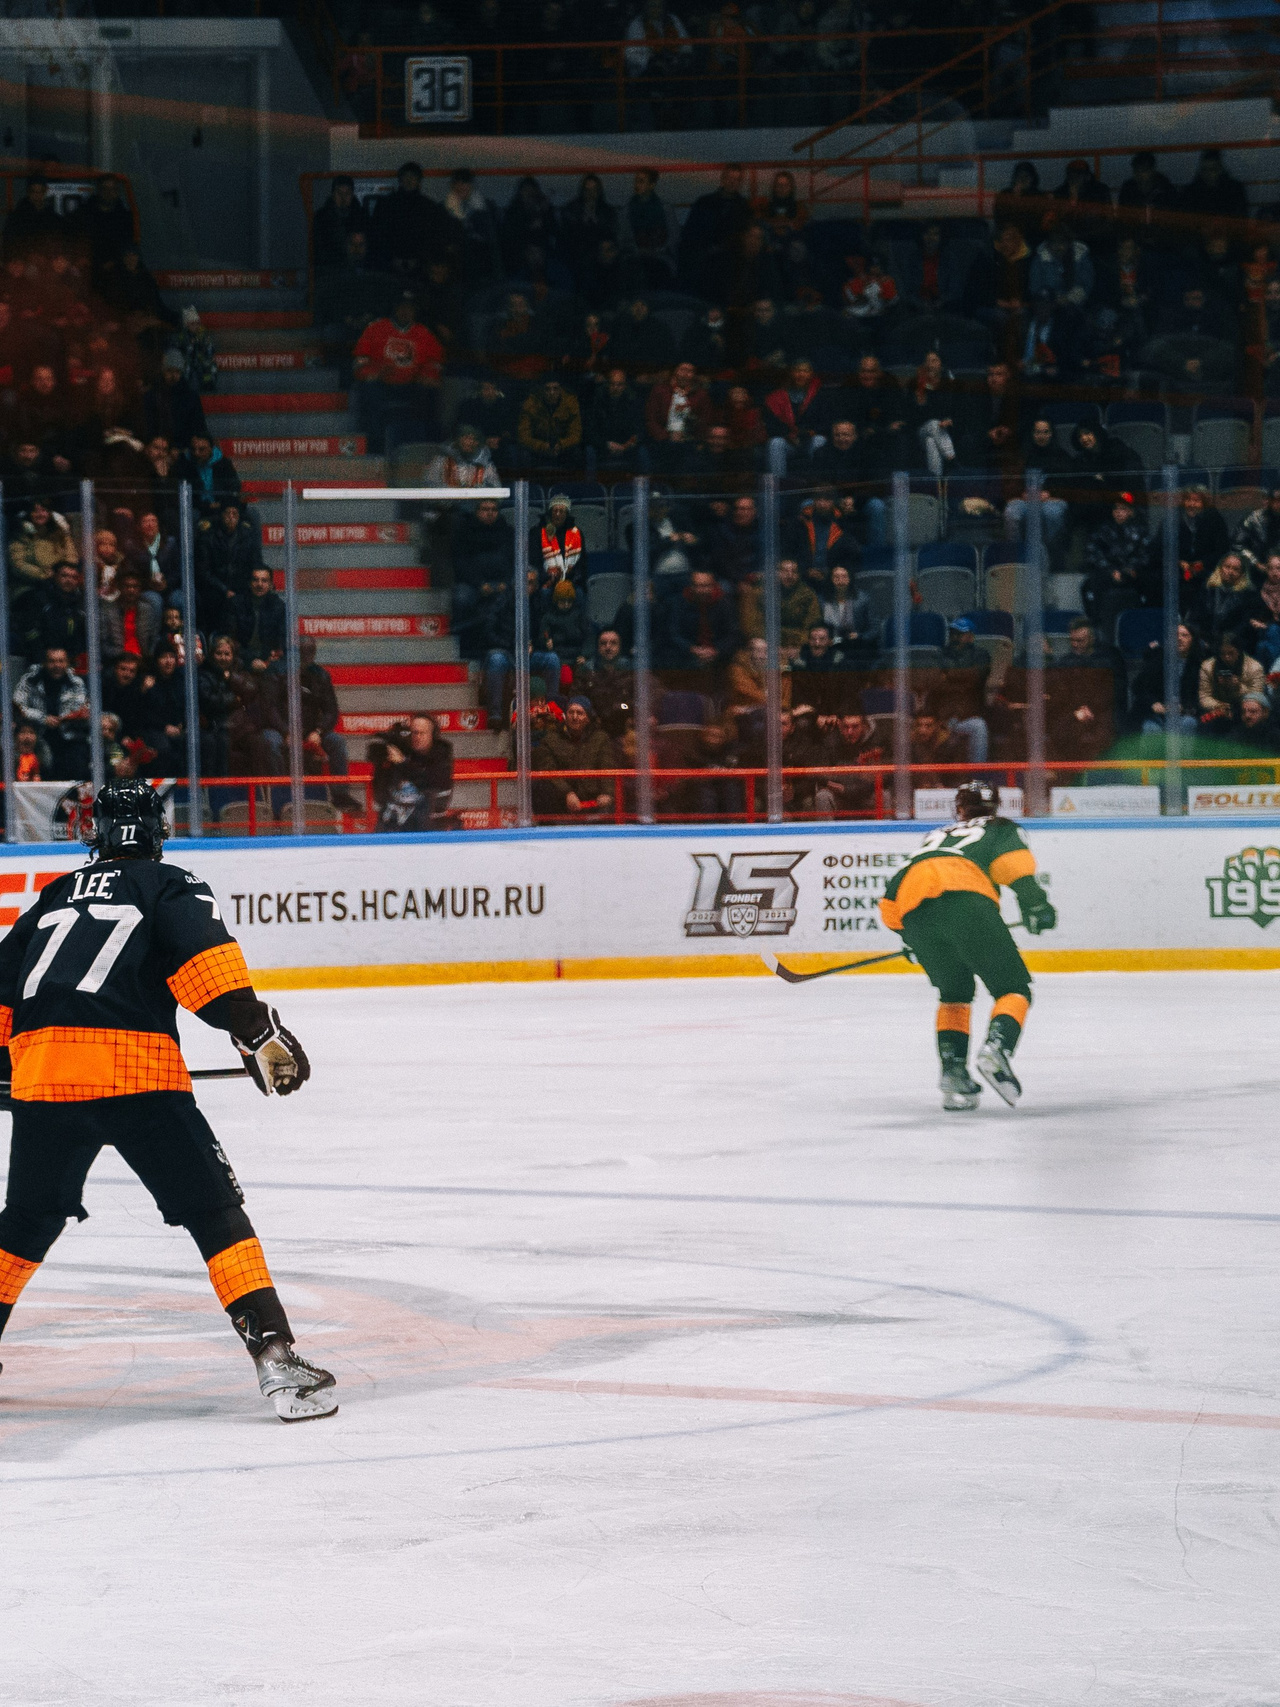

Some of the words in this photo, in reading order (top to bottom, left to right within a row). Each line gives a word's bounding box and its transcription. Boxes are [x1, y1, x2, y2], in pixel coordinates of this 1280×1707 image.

[413, 67, 462, 112] 36
[121, 824, 137, 842] 77
[71, 871, 117, 900] LEE
[724, 893, 763, 904] FONBET
[231, 885, 546, 926] TICKETS.HCAMUR.RU
[823, 916, 879, 932] ЛИГА
[22, 903, 145, 1001] 77
